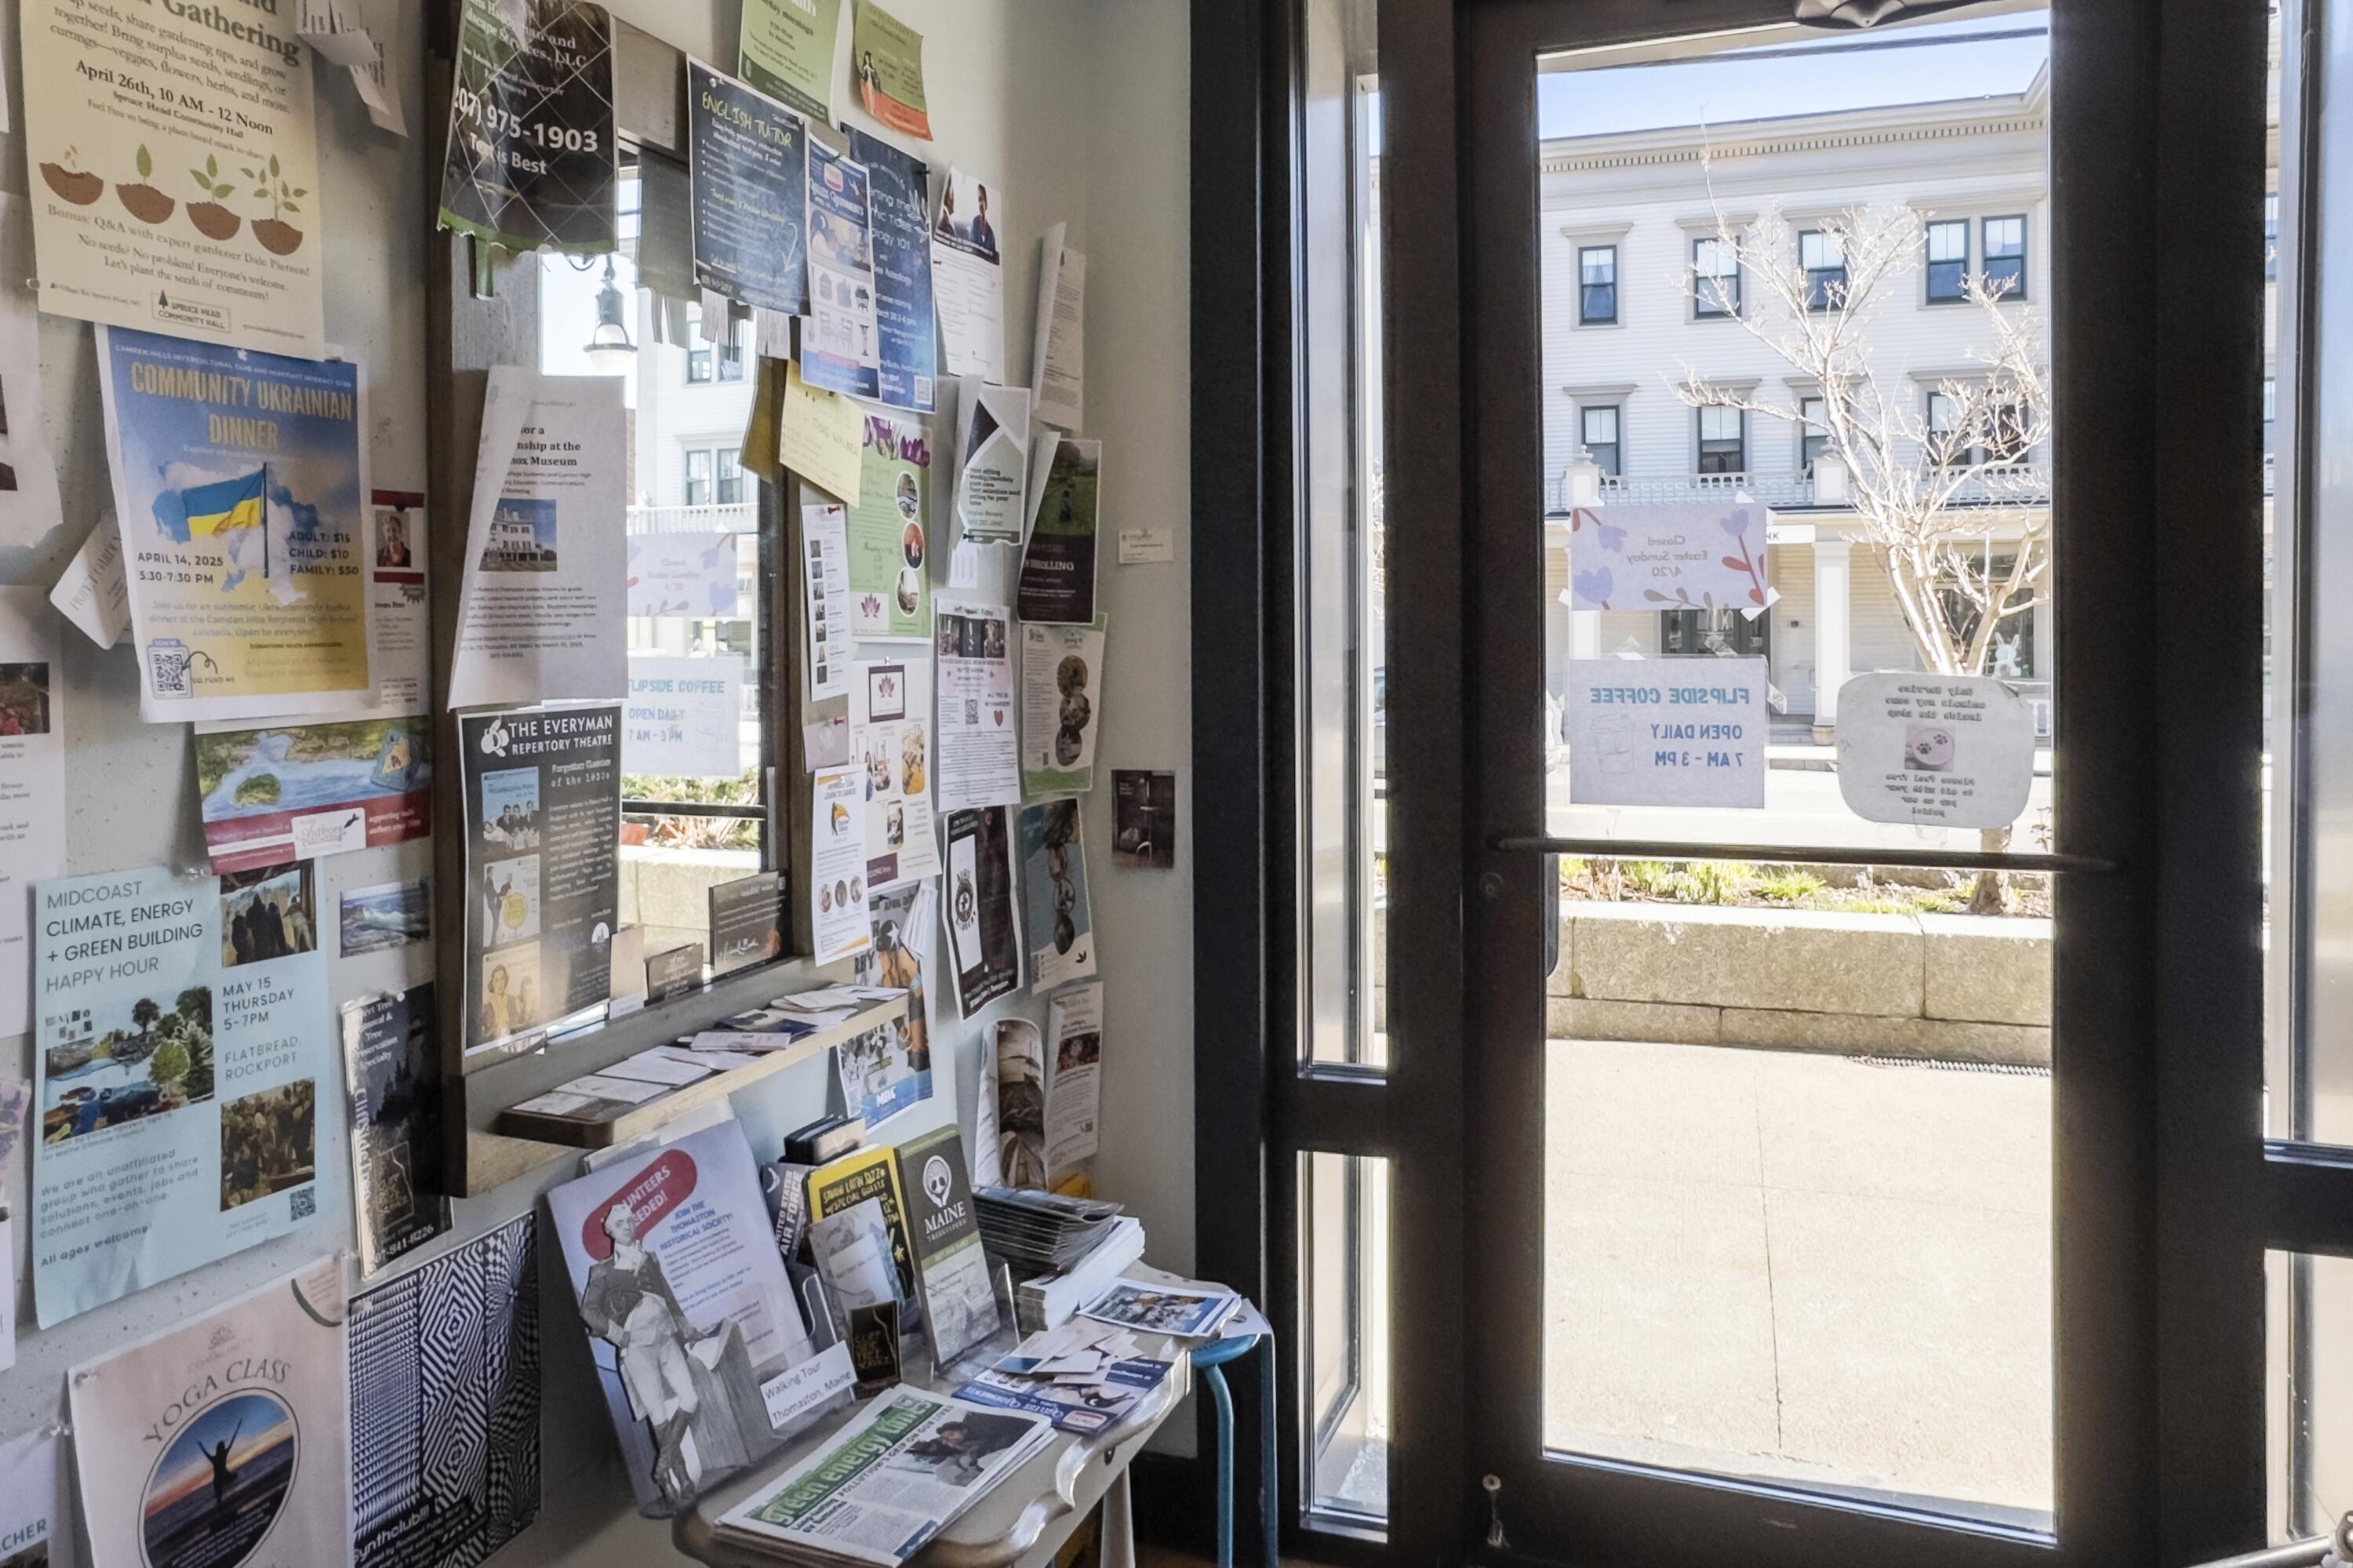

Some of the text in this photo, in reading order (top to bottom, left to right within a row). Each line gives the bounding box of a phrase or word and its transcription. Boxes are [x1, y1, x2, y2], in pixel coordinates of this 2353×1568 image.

[54, 6, 186, 63] together! Bring surplus
[126, 13, 259, 72] share gardening and
[165, 0, 300, 67] Gathering
[550, 31, 576, 49] and
[555, 49, 587, 68] LLC
[75, 59, 114, 84] April
[118, 74, 155, 100] 26th,
[158, 87, 174, 103] 10
[178, 96, 204, 115] AM
[217, 107, 233, 122] 12
[235, 111, 273, 135] Noon
[241, 88, 260, 104] and
[486, 104, 599, 153] 975-1903
[701, 90, 753, 131] ENGLISH
[754, 118, 793, 150] TUTOR
[469, 131, 548, 176] Text is Best
[78, 233, 150, 260] No No
[93, 215, 268, 267] Q&A with expert gardener Dale
[130, 261, 215, 290] plant the seeds of
[158, 309, 226, 329] COMMUNITY HALL
[171, 302, 200, 315] SPRUCE
[130, 361, 353, 421] COMMUNITY UKRAINIAN
[208, 413, 279, 448] DINNER
[520, 425, 536, 435] or
[550, 441, 581, 452] at the
[530, 456, 578, 467] Museum
[289, 531, 351, 544] ADULT: $15
[137, 551, 224, 568] APRIL 14, 2025
[289, 547, 350, 559] CHILD: $10
[139, 570, 214, 584] 5:30-7:30 PM
[289, 563, 359, 577] FAMILY: $50
[627, 678, 726, 694] FLIPSIDE COFFEE
[507, 715, 613, 739] THE EVERYMAN
[628, 708, 686, 721] OPEN DAILY
[511, 734, 613, 755] REPERTORY THEATRE
[628, 728, 684, 743] 7 AM PM
[551, 774, 582, 788] of the
[46, 880, 143, 909] MIDCOAST
[46, 898, 195, 937] CLIMATE, ENERGY
[47, 922, 204, 962] + GREEN BUILDING
[45, 956, 159, 994] HAPPY HOUR
[222, 976, 272, 998] MAY 15
[222, 988, 295, 1014] THURSDAY
[224, 1010, 270, 1031] 5-7PM
[365, 1029, 384, 1042] Tree
[225, 1051, 297, 1081] ROCKPORT
[40, 1155, 199, 1213] group who gather to share
[42, 1148, 176, 1196] We are an unaffiliated
[622, 1164, 671, 1209] UNTEERS
[40, 1199, 99, 1226] solutions,
[150, 1177, 174, 1192] jobs
[177, 1167, 199, 1181] and
[780, 1170, 795, 1209] STATES
[635, 1188, 668, 1225] EEDED!
[670, 1208, 716, 1234] THOMASTON
[675, 1200, 706, 1221] JOIN THE
[780, 1170, 804, 1256] AIR FORCE
[924, 1201, 966, 1234] MAINE
[40, 1215, 91, 1240] connect
[660, 1227, 701, 1251] HISTORICAL
[40, 1254, 56, 1268] All
[60, 1243, 91, 1261] ages
[764, 1360, 823, 1400] Walking Tour
[142, 1358, 293, 1443] YOGA CLASS
[771, 1370, 852, 1423] Thomaston, Maine
[887, 1420, 936, 1458] GRIP ON OUR
[761, 1475, 829, 1526] green
[820, 1432, 894, 1483] energy
[0, 1518, 47, 1553] CHER
